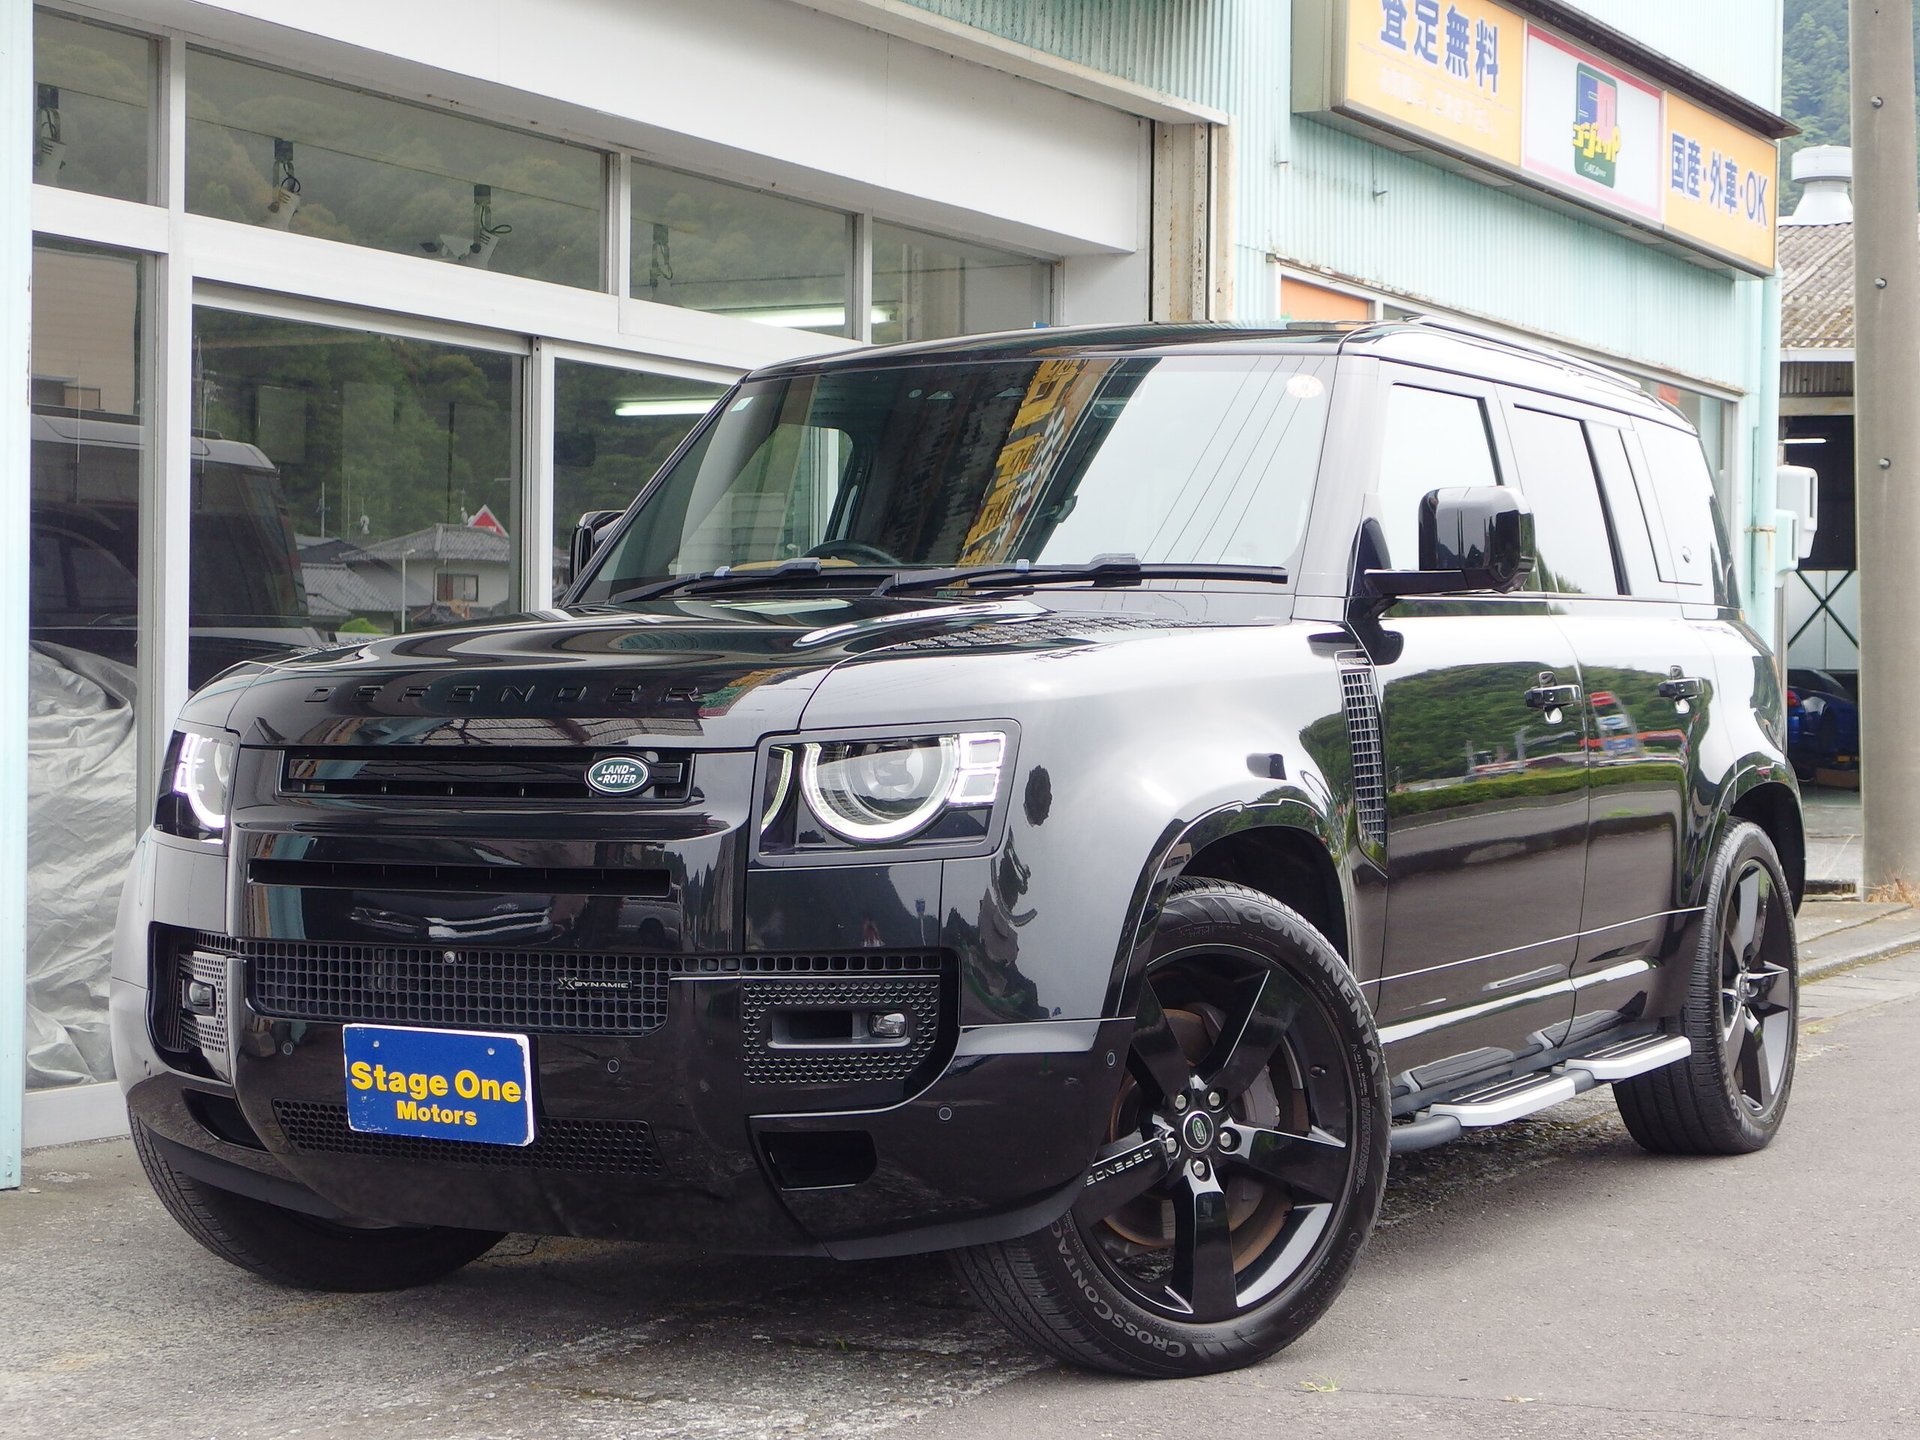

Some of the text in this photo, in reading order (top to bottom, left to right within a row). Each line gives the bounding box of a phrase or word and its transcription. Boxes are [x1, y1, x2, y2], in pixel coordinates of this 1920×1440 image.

[1380, 0, 1498, 93] 査定無料
[304, 685, 699, 703] DEFENDER
[350, 1061, 522, 1103] Stage One
[396, 1100, 478, 1126] Motors
[1083, 1148, 1153, 1188] DEFENDE
